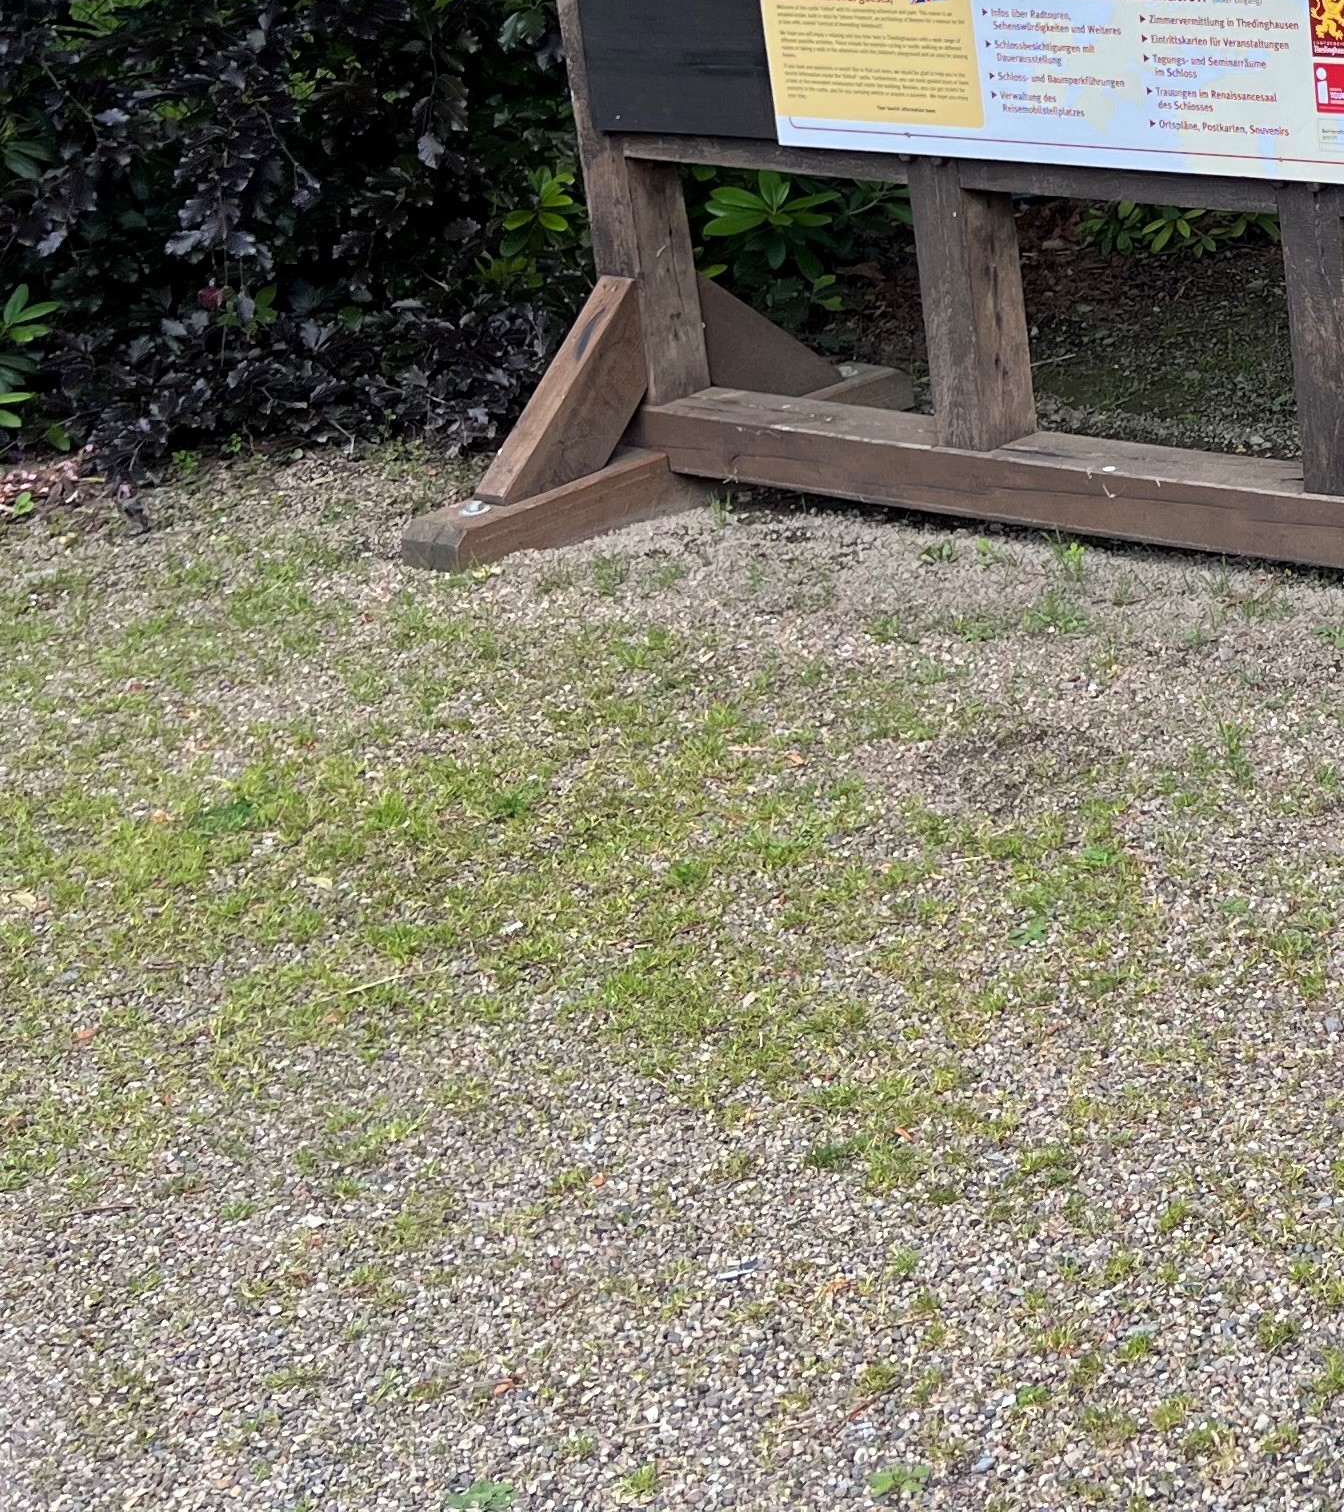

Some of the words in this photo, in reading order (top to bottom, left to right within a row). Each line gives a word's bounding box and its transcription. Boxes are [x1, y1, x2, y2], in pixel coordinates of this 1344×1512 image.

[990, 8, 1009, 17] Infos
[1011, 9, 1028, 17] über
[1030, 9, 1071, 20] Radtouren,
[992, 21, 1069, 34] Sehenswürdigkeiten
[1071, 24, 1085, 33] und
[1087, 25, 1121, 35] Weiteres
[1148, 15, 1224, 28] Zimmervermittlung
[1226, 18, 1234, 26] in
[1236, 18, 1298, 31] Thedinghausen
[994, 40, 1080, 54] Schlossbesichtigungen
[1082, 44, 1094, 53] mit
[1151, 34, 1207, 45] Eintrittskarten
[1209, 37, 1221, 46] für
[1222, 37, 1289, 51] Veranstaltungen
[996, 53, 1062, 66] Dauerausstellung
[1190, 55, 1205, 65] und
[1207, 56, 1266, 68] Seminarräume
[997, 71, 1028, 82] Schloss-
[1031, 73, 1045, 82] und
[1047, 74, 1125, 88] Baumparkführungen
[1154, 67, 1164, 76] im
[1166, 67, 1197, 78] Schloss
[999, 91, 1041, 103] Verwaltung
[1043, 93, 1056, 102] des
[1155, 87, 1197, 100] Trauungen
[1198, 89, 1208, 98] im
[1210, 89, 1276, 102] Renaissancesaal
[1002, 103, 1085, 118] Reisemobilstellplatzes
[1157, 99, 1172, 109] des
[1174, 100, 1213, 111] Schlosses
[1158, 119, 1199, 132] Ortspläne,
[1201, 121, 1248, 134] Postkarten,
[1249, 124, 1289, 136] Souvenirs
